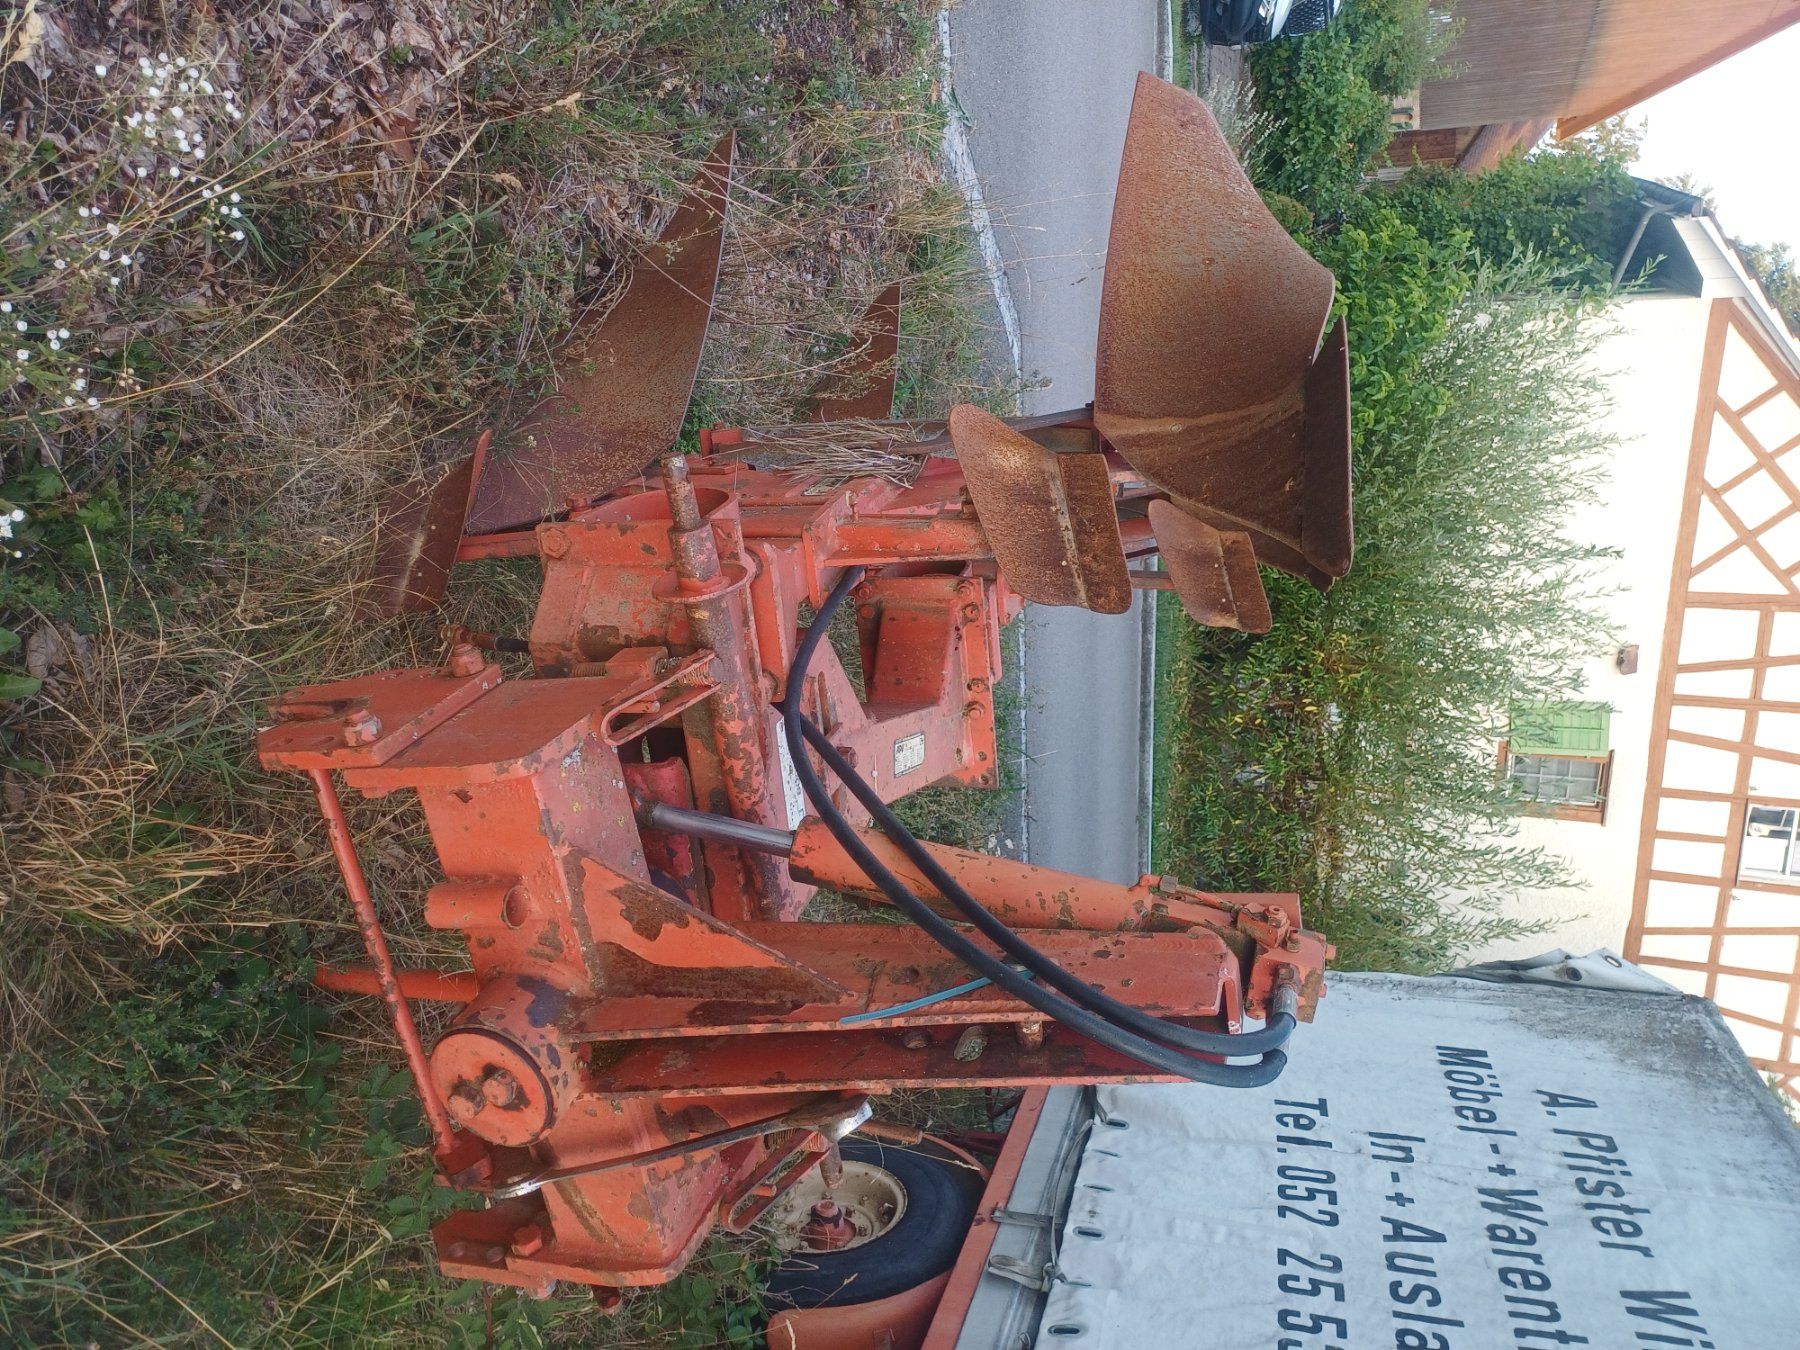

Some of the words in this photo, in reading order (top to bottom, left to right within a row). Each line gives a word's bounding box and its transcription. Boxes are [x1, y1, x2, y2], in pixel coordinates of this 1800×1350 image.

[1273, 1097, 1334, 1155] Tel.
[1534, 1089, 1600, 1118] A.
[1276, 1164, 1341, 1229] 052
[1551, 1126, 1656, 1259] Pfister
[1379, 1215, 1466, 1350] Ausla
[1476, 1187, 1591, 1350] Warent
[1618, 1289, 1717, 1350] Wi
